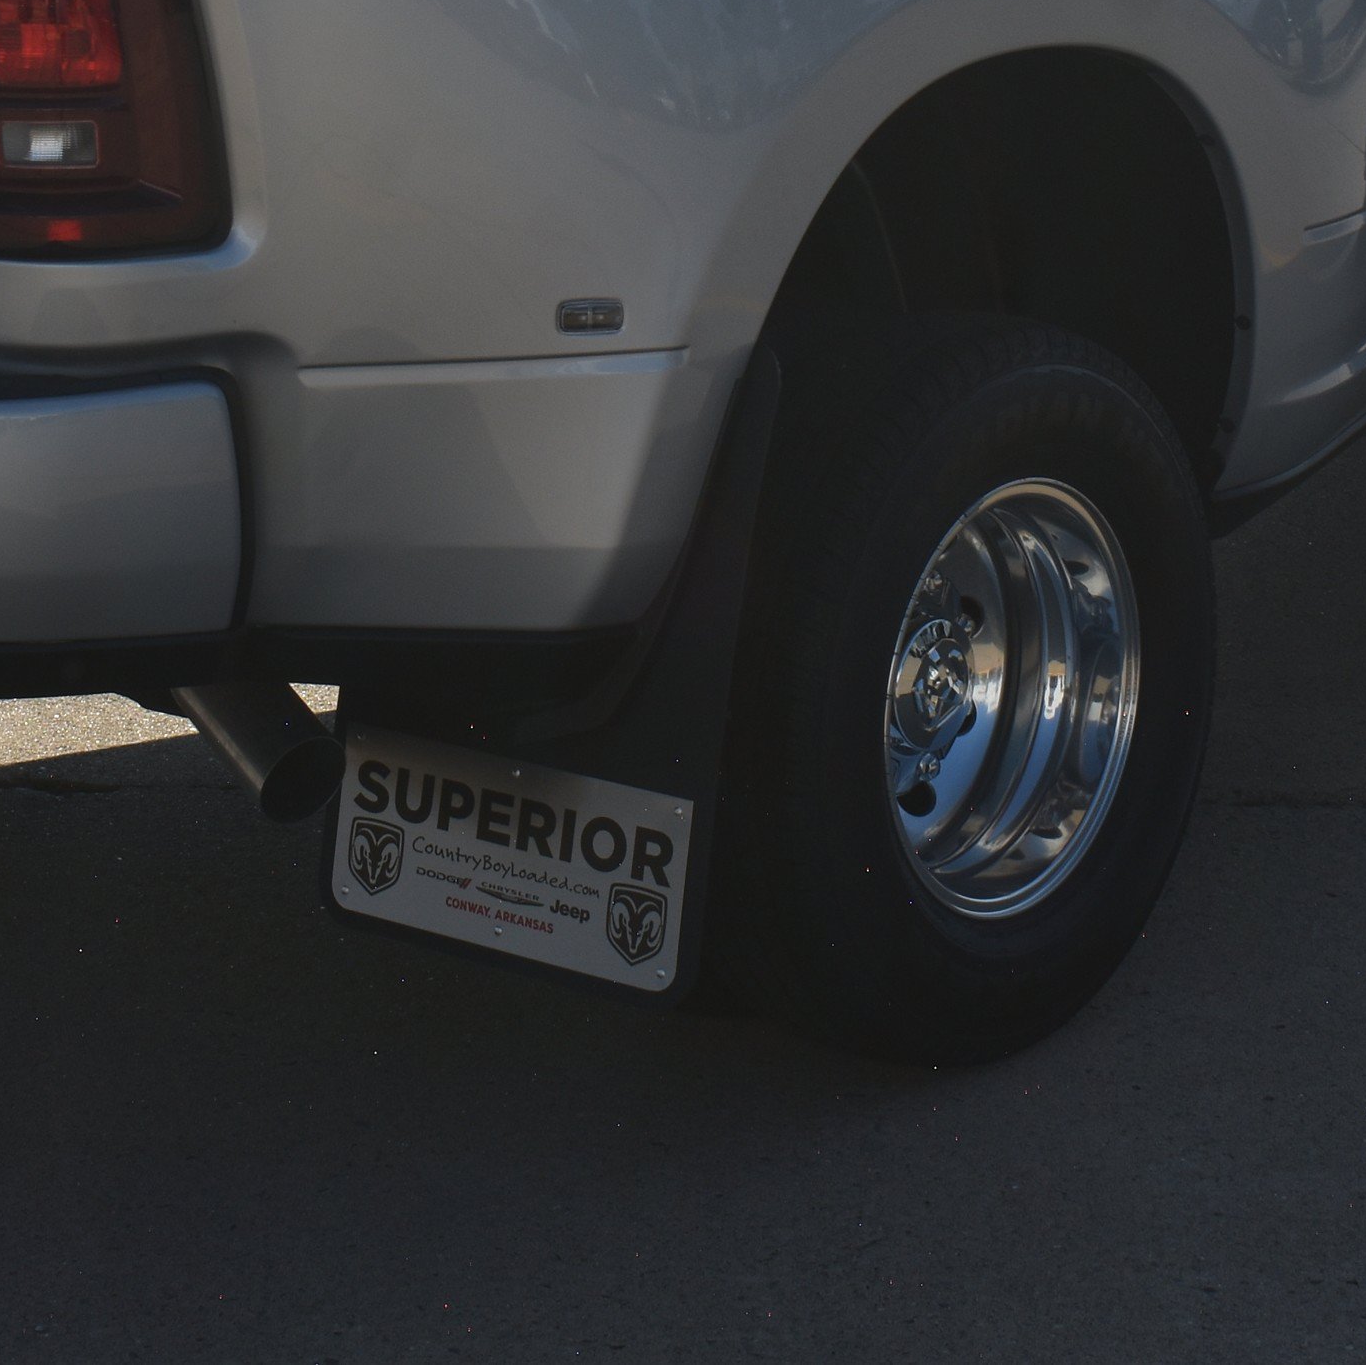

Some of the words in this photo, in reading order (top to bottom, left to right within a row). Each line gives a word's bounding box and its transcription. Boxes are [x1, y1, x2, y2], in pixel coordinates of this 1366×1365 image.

[353, 759, 674, 889] SUPERIOR
[412, 835, 601, 899] CountryBoyLoaded.com
[415, 865, 465, 886] DODGE
[481, 881, 540, 902] CHRYSLER
[549, 898, 591, 924] Jeep
[445, 895, 492, 918] CONWAY,
[494, 909, 554, 935] ARKANSAS
